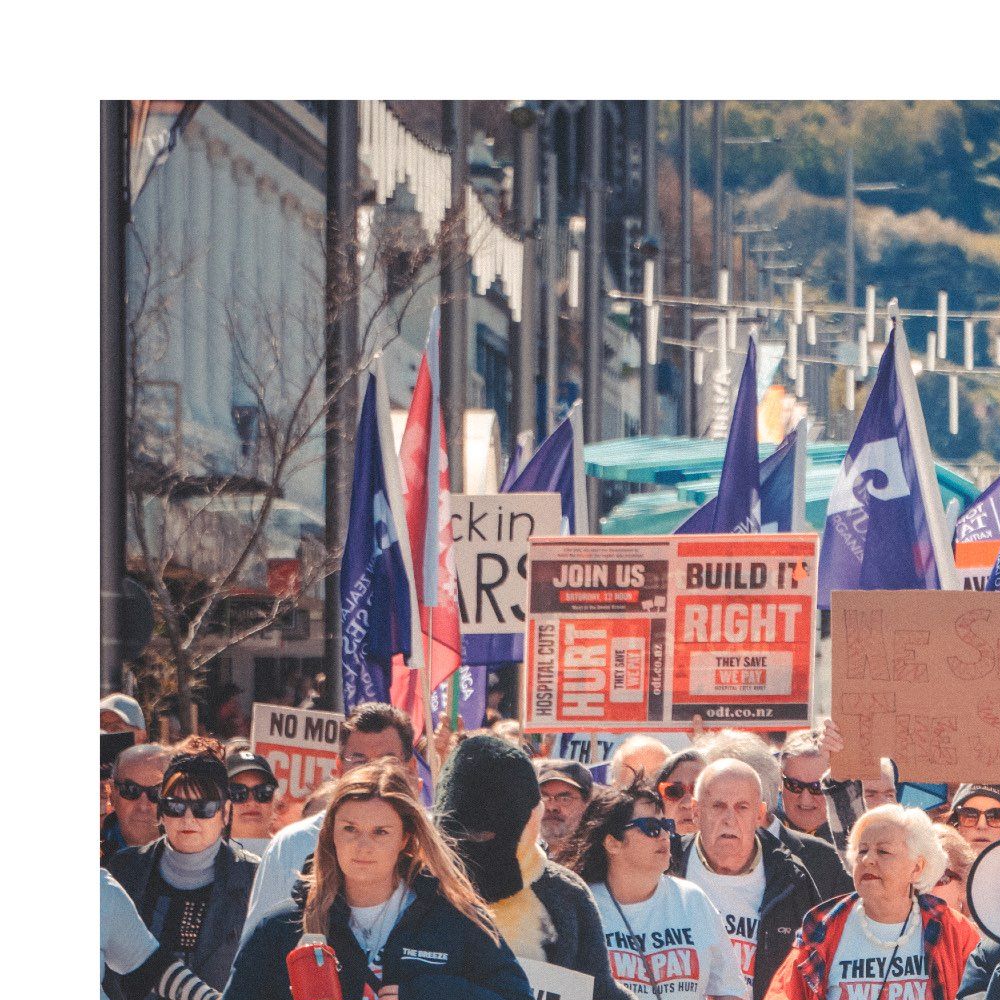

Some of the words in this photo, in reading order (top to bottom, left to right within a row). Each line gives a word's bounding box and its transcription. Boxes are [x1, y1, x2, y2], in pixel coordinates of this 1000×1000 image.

[451, 501, 535, 542] ckin
[553, 563, 609, 588] JOIN
[615, 563, 646, 588] US
[686, 562, 768, 590] BUILD
[777, 562, 809, 590] IT
[683, 603, 803, 643] RIGHT
[537, 623, 556, 656] CUTS
[561, 623, 608, 717] HURT
[614, 649, 625, 668] SAVE
[651, 643, 663, 695] odt.co.nz
[715, 656, 741, 668] THEY
[743, 656, 767, 668] SAVE
[536, 657, 555, 716] HOSPITAL
[614, 669, 625, 690] THEY
[706, 705, 774, 718] odt.co.nz
[269, 712, 298, 738] NO
[304, 716, 338, 744] MO
[570, 740, 614, 764] THY
[268, 751, 338, 799] CUT
[725, 914, 760, 939] SAV
[605, 932, 647, 953] THEY
[651, 927, 695, 949] SAVE
[402, 947, 418, 957] THE
[418, 950, 449, 961] BREEZE
[613, 950, 651, 982] WE
[652, 949, 693, 982] PAY
[839, 957, 887, 980] THEY
[652, 981, 675, 995] CUTS
[678, 981, 698, 993] HURT
